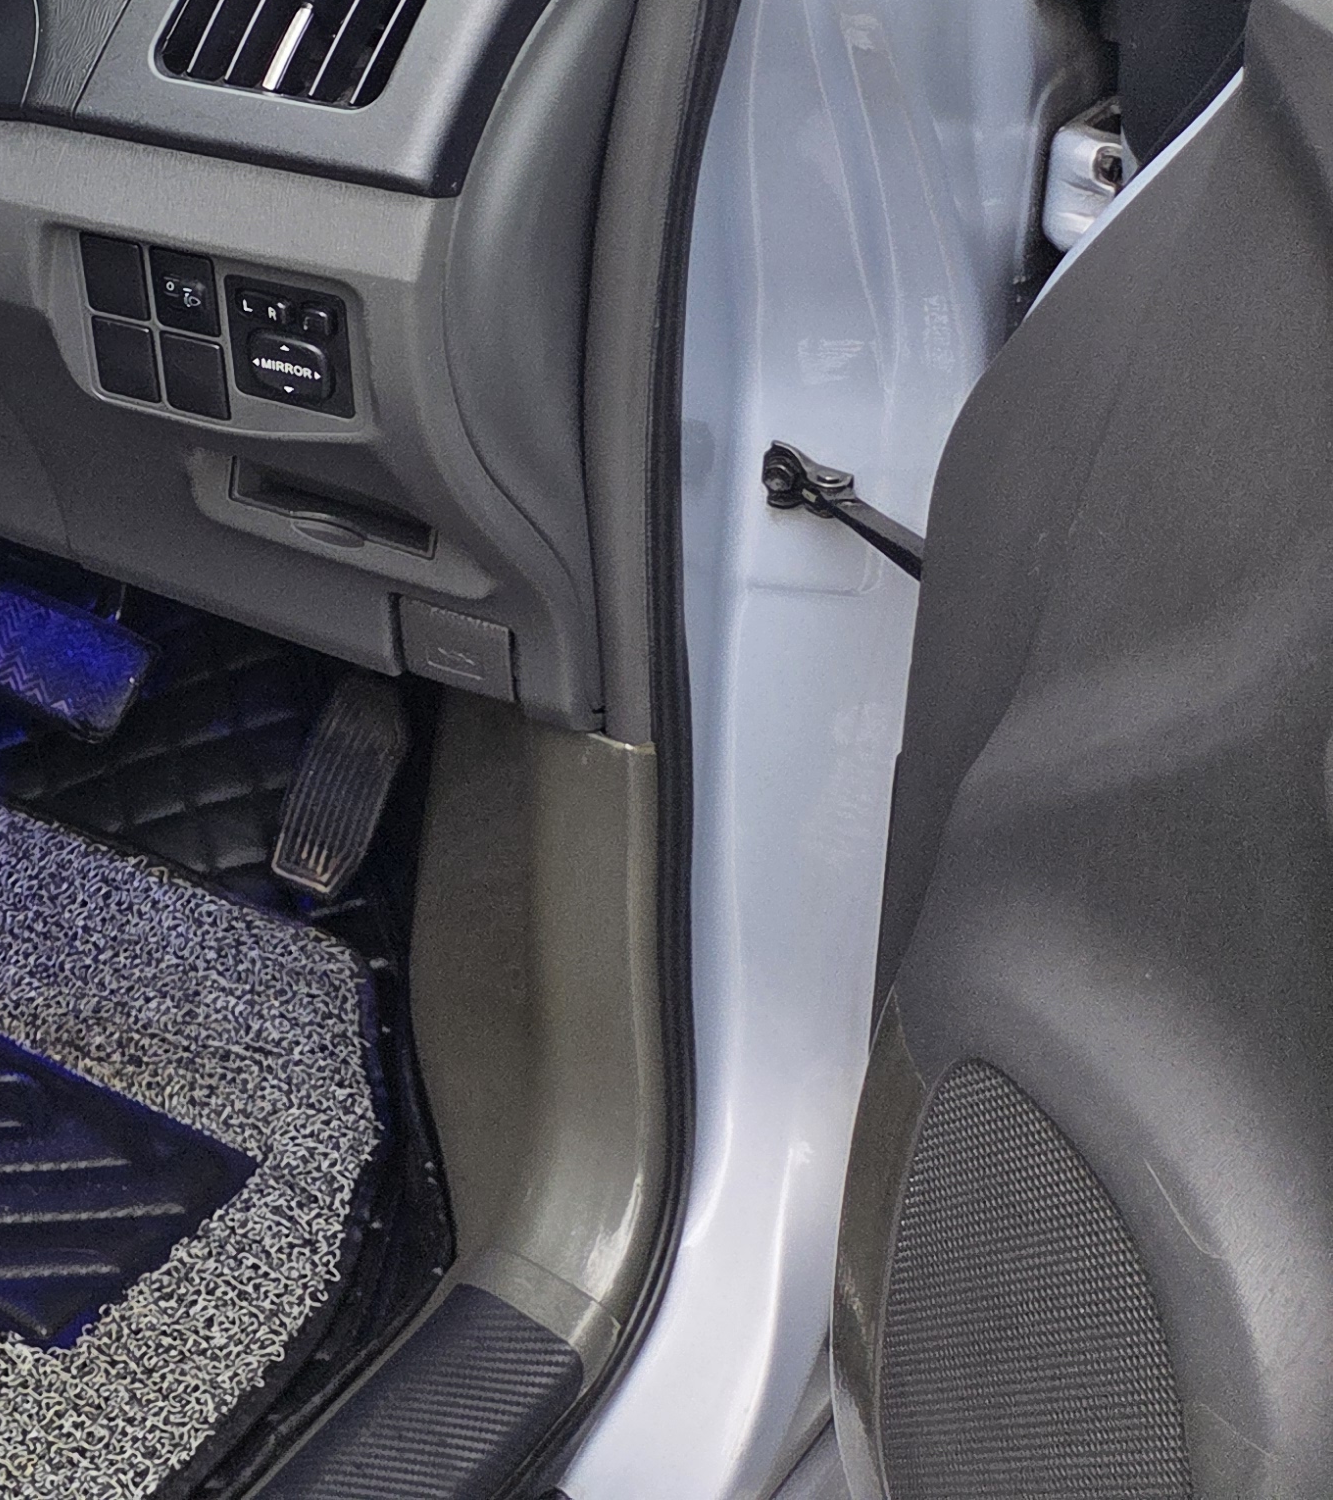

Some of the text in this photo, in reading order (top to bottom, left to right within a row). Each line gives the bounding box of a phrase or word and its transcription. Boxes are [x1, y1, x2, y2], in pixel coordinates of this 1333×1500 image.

[242, 298, 277, 321] L R
[261, 357, 313, 380] MIRROR
